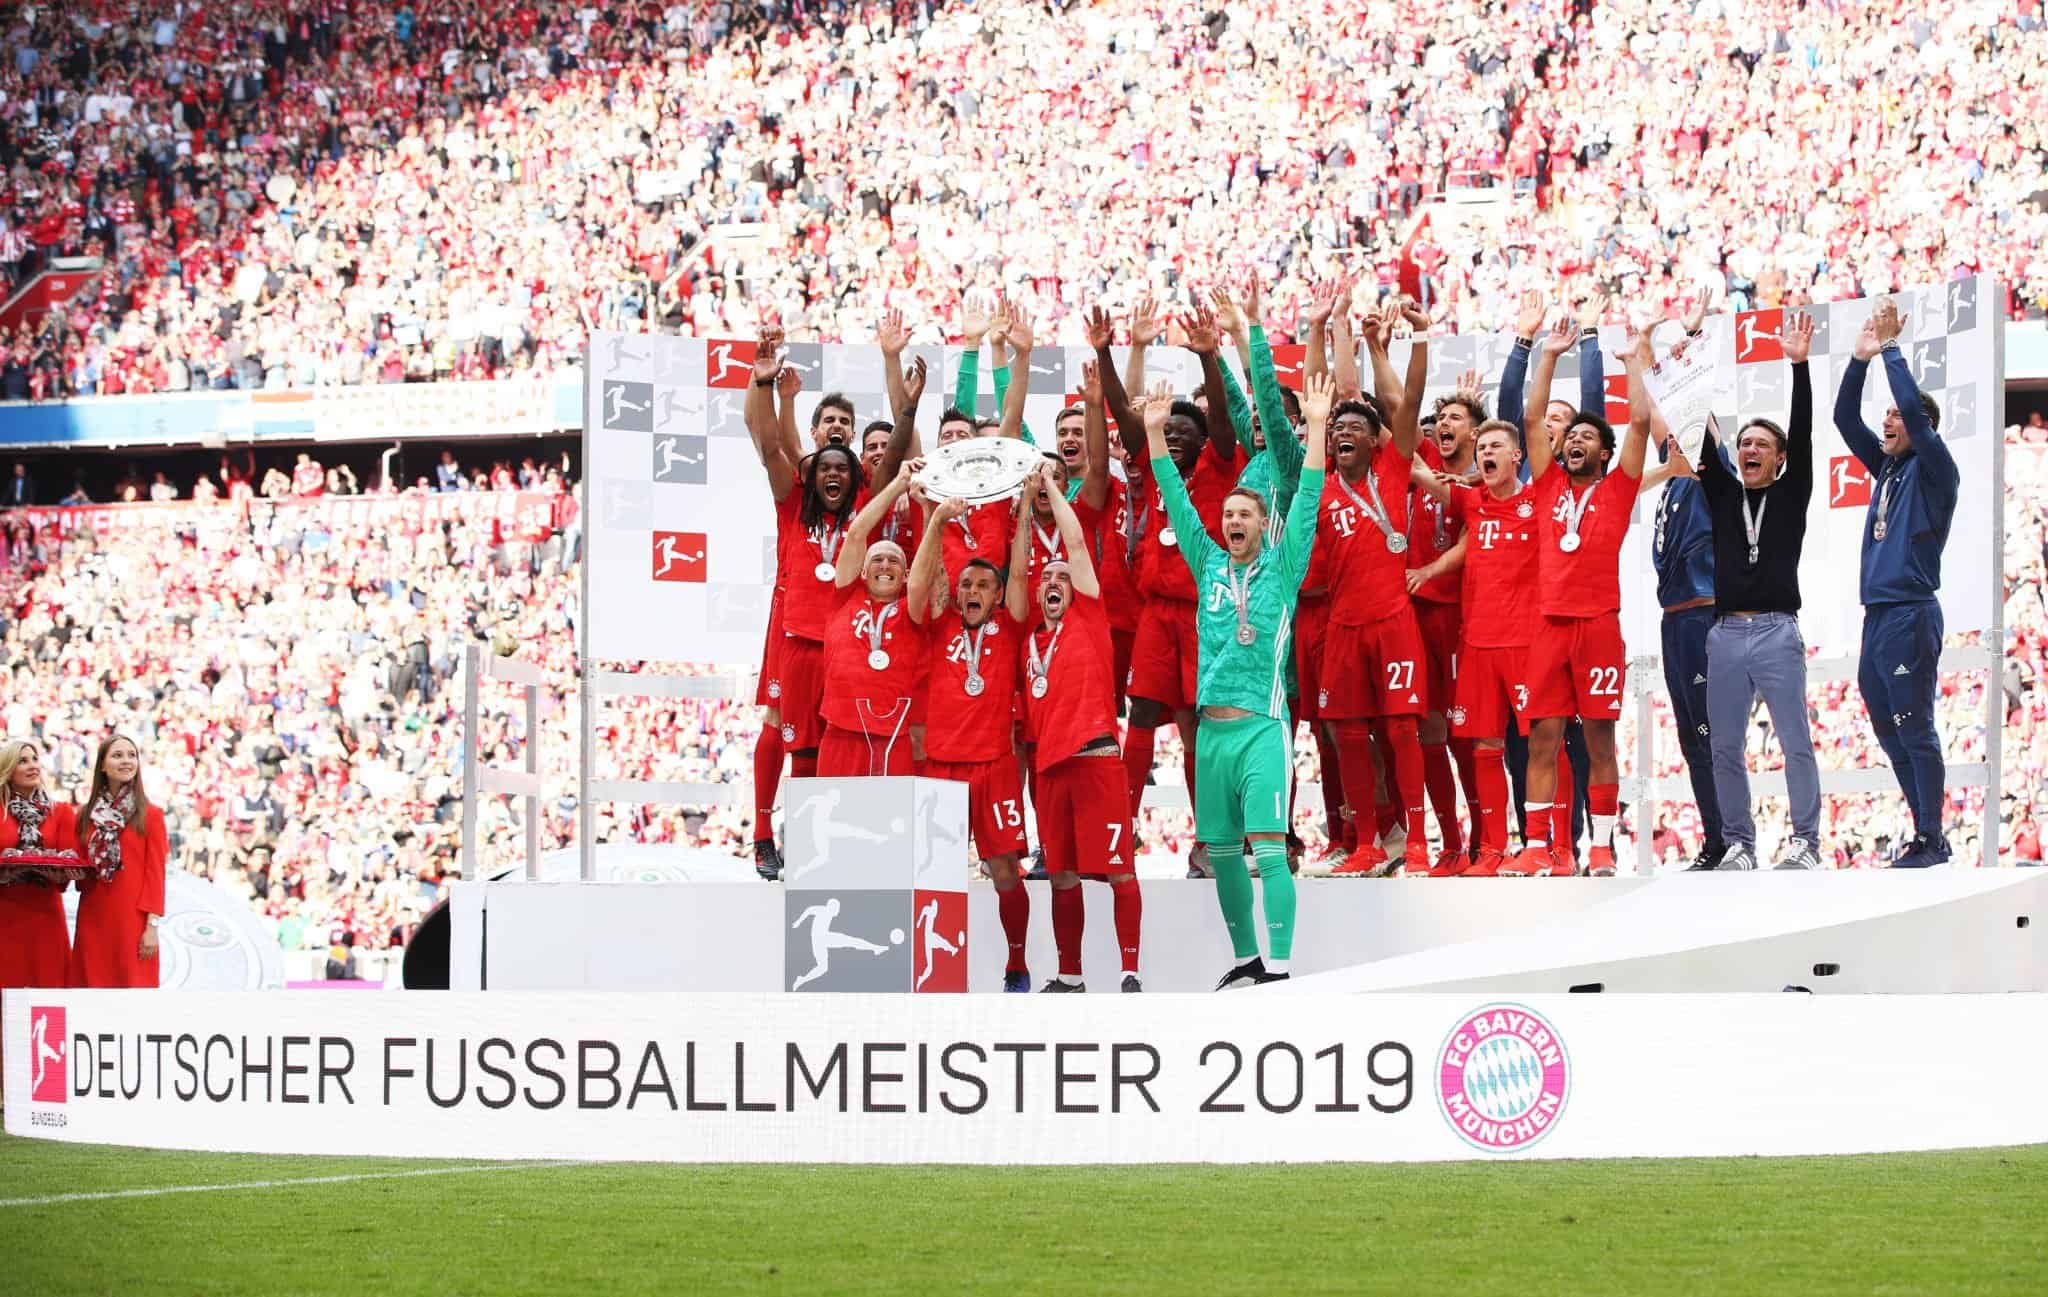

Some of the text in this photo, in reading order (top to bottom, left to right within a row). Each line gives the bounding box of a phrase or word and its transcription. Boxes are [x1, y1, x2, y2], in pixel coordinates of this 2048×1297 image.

[1387, 660, 1414, 690] 27
[1589, 666, 1619, 695] 22
[993, 799, 1022, 830] 13
[1274, 791, 1281, 819] 1
[1106, 823, 1122, 852] 7
[1445, 1012, 1561, 1068] FC BAYERN
[74, 1033, 1413, 1115] DEUTSCHER FUSSBALLMEISTER 2019
